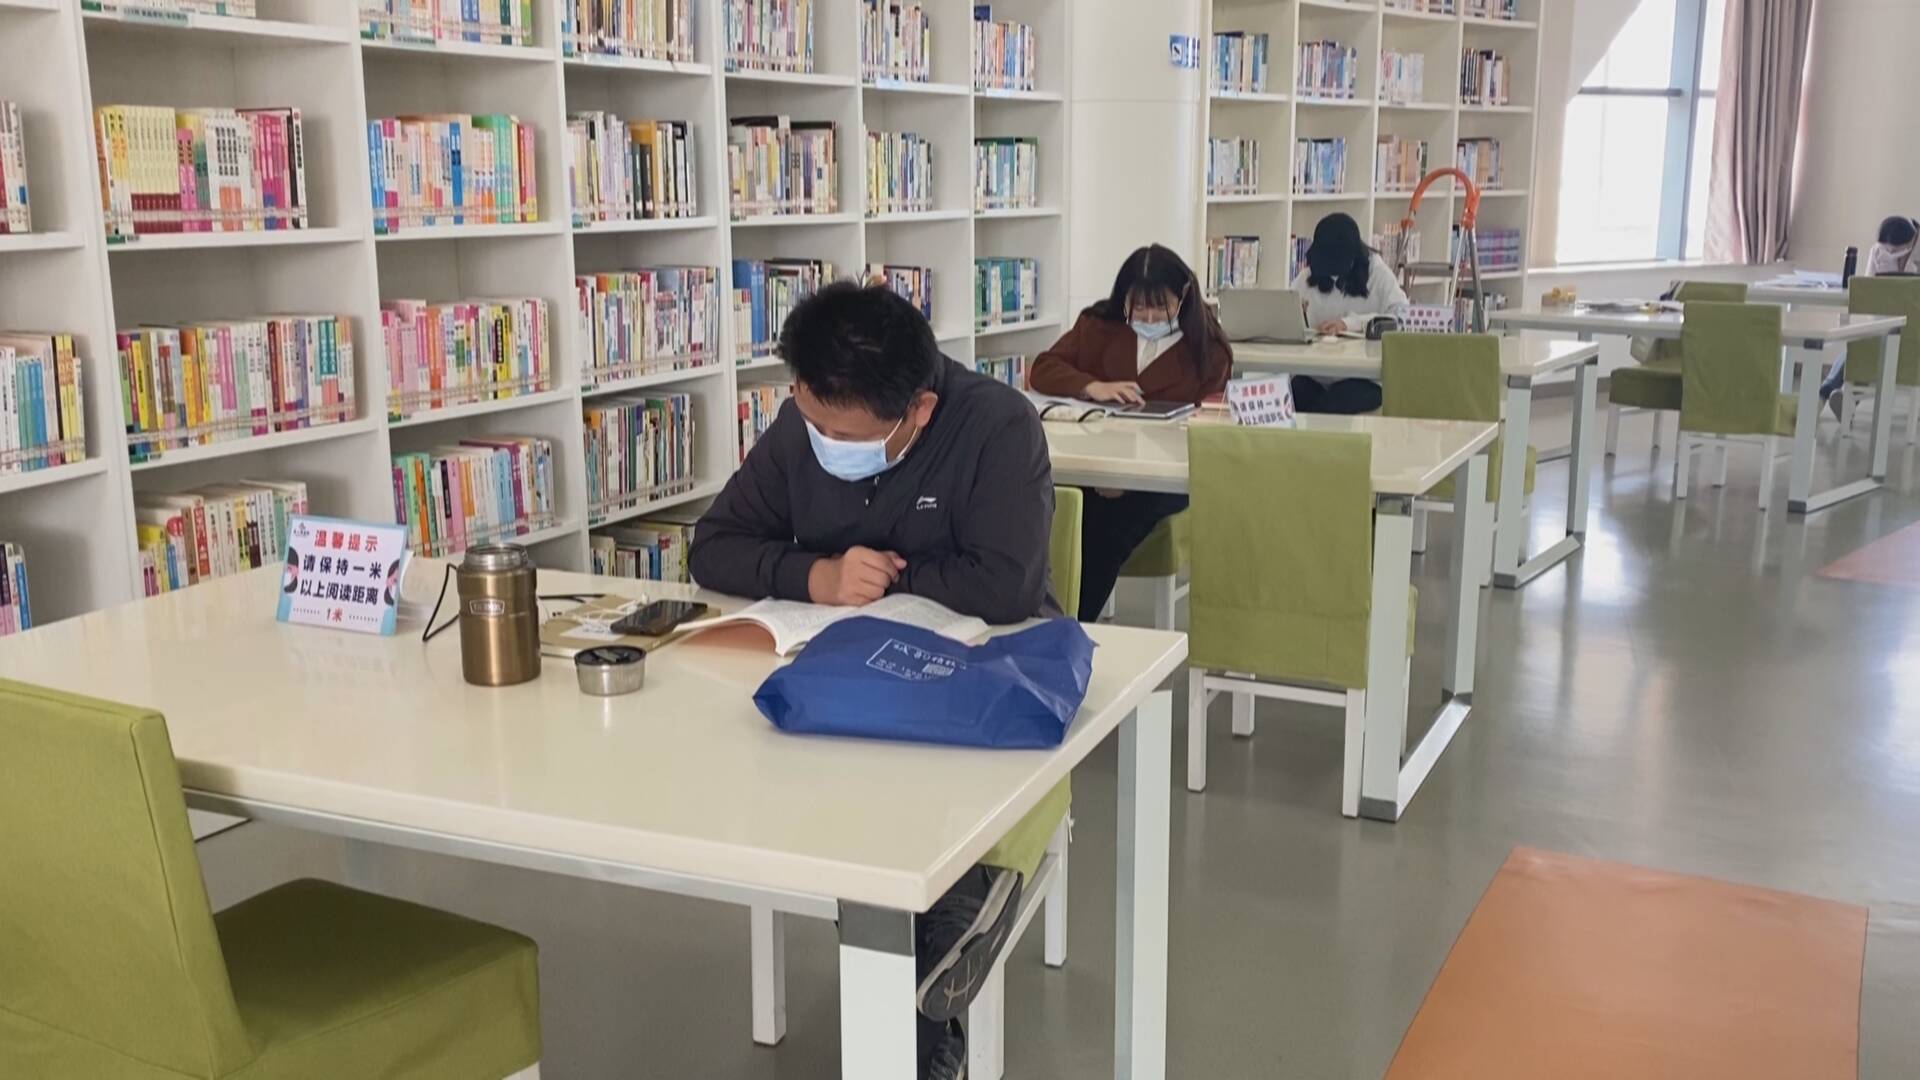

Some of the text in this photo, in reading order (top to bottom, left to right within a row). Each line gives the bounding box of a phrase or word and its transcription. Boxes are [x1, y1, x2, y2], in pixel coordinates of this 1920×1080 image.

[314, 529, 378, 553] 温馨提示
[303, 554, 382, 580] 请保持一米
[299, 578, 380, 606] 以上阅读距离
[326, 607, 343, 622] 1米
